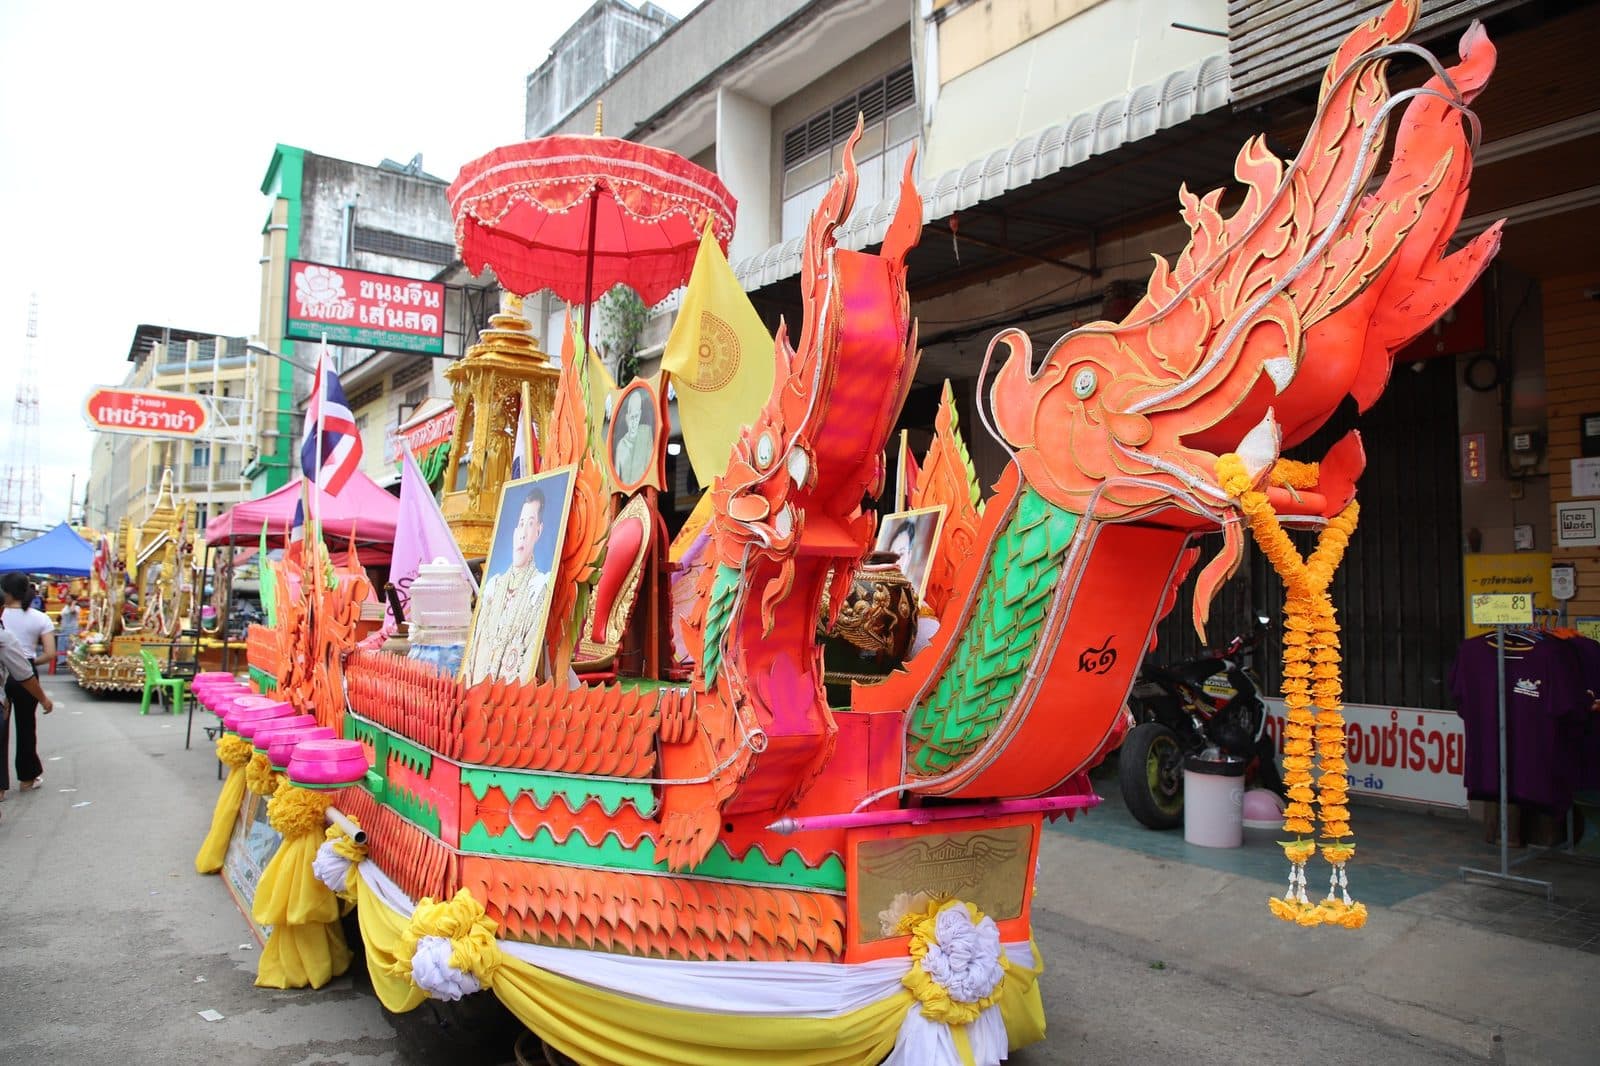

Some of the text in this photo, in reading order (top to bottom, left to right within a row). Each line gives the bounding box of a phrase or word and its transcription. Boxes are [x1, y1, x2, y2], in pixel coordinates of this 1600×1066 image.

[359, 280, 440, 308] ขนมจีน
[359, 301, 438, 334] เส้นสด
[1511, 596, 1526, 610] 89
